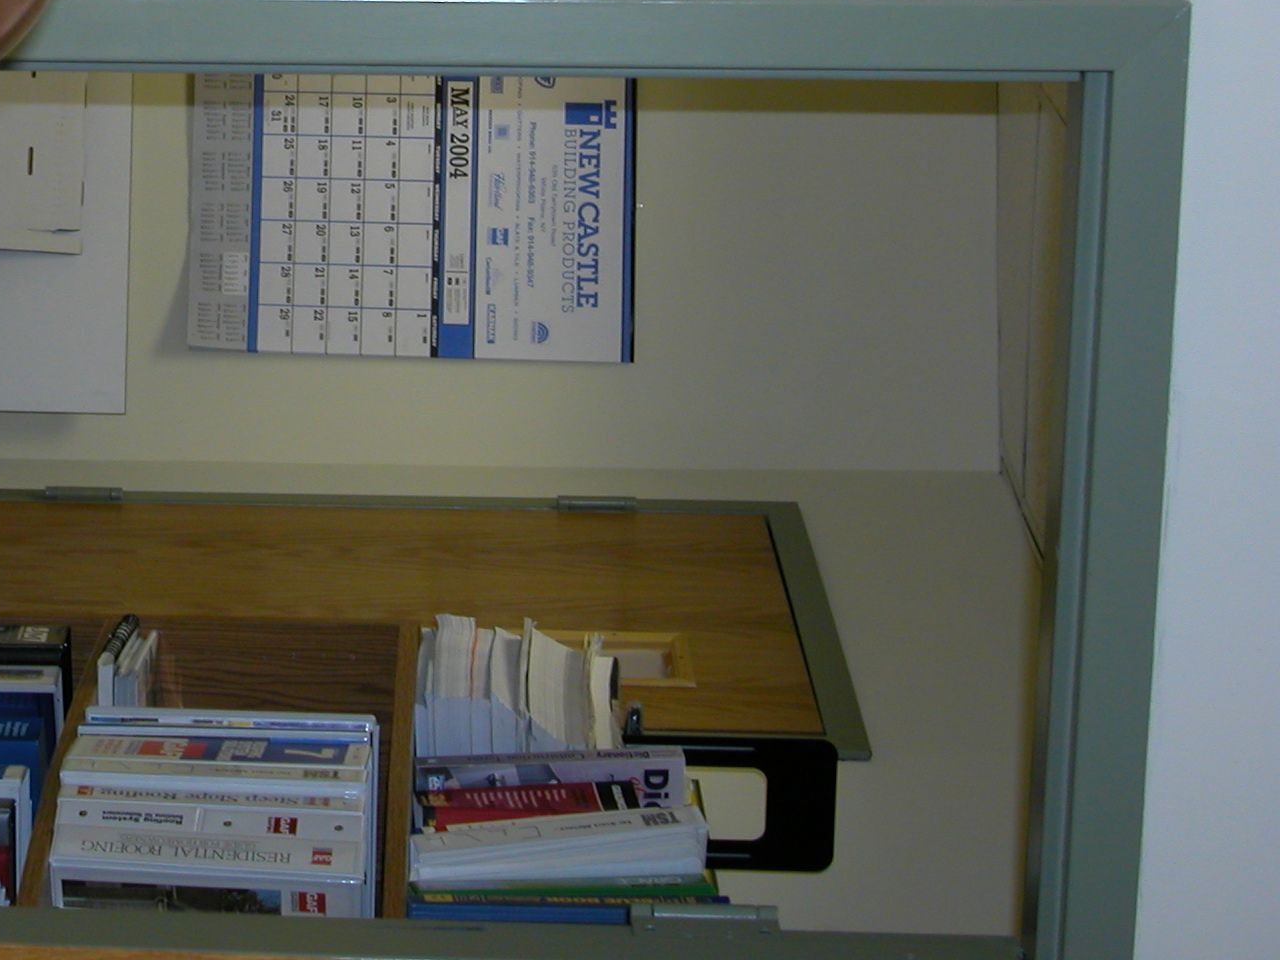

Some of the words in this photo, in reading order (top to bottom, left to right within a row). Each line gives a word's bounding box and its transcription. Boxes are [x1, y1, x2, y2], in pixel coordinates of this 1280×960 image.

[285, 94, 295, 106] 24
[319, 96, 329, 107] 17
[352, 97, 363, 108] 10
[450, 88, 470, 129] MAY
[272, 110, 281, 122] 31
[284, 137, 294, 150] 25
[318, 139, 328, 150] 18
[352, 140, 362, 150] 11
[449, 133, 469, 179] 2004
[579, 129, 601, 198] NEW
[563, 129, 576, 213] BUILDING
[283, 180, 293, 193] 26
[317, 182, 327, 193] 19
[351, 183, 361, 194] 12
[282, 223, 292, 235] 27
[316, 224, 326, 236] 20
[350, 226, 360, 237] 13
[577, 202, 600, 309] CASTLE
[281, 266, 291, 278] 28
[315, 267, 325, 279] 21
[561, 221, 575, 313] PRODUCTS
[349, 269, 359, 280] 14
[280, 308, 290, 320] 29
[314, 310, 324, 321] 22
[348, 311, 358, 322] 15
[245, 795, 299, 807] Steep
[640, 812, 680, 826] TSM
[80, 840, 162, 856] ROOFING
[171, 846, 291, 864] RESIDENTIAL
